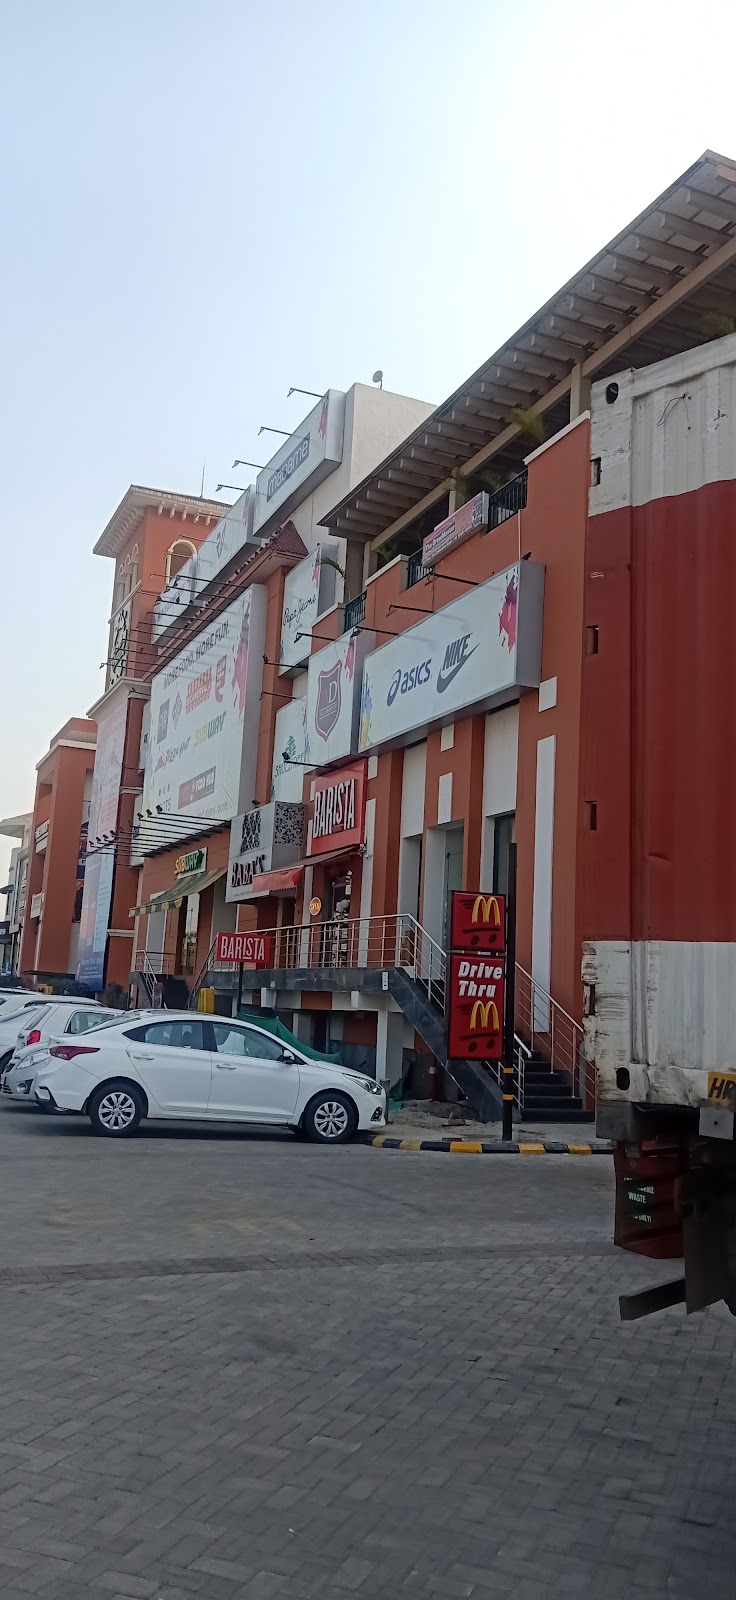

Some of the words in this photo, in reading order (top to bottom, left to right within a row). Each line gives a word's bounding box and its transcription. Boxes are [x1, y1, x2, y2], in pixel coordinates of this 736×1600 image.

[442, 633, 471, 671] NIKE
[194, 711, 227, 747] SUBWAY
[313, 778, 355, 839] BARISTA
[174, 851, 204, 875] SUBWAY
[230, 855, 265, 888] BABA'S
[220, 935, 265, 960] BARISTA
[458, 961, 502, 980] Drive
[458, 980, 496, 998] Thru
[628, 1192, 646, 1204] WASTE
